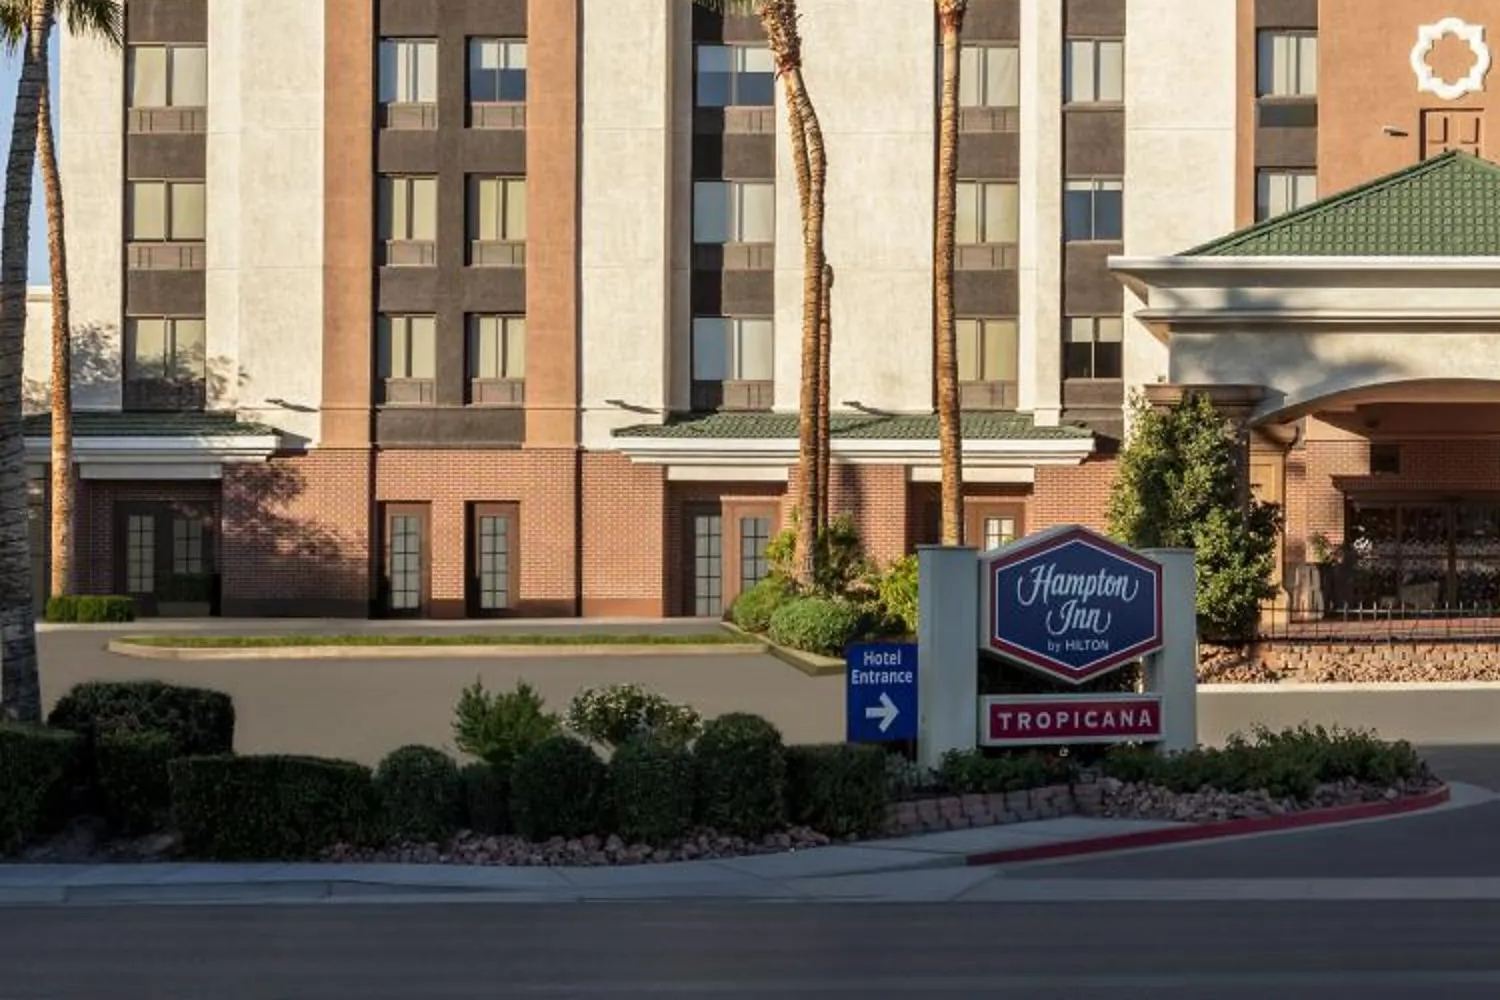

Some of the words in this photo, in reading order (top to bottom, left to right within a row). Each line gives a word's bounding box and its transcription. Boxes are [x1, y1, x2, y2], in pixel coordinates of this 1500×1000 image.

[1016, 562, 1140, 606] Hampton
[1046, 600, 1112, 636] Inn
[1047, 640, 1061, 653] by
[1065, 639, 1109, 651] HILTON
[863, 649, 901, 666] Hotel
[851, 669, 913, 685] Entrance
[997, 709, 1153, 731] TROPICANA
